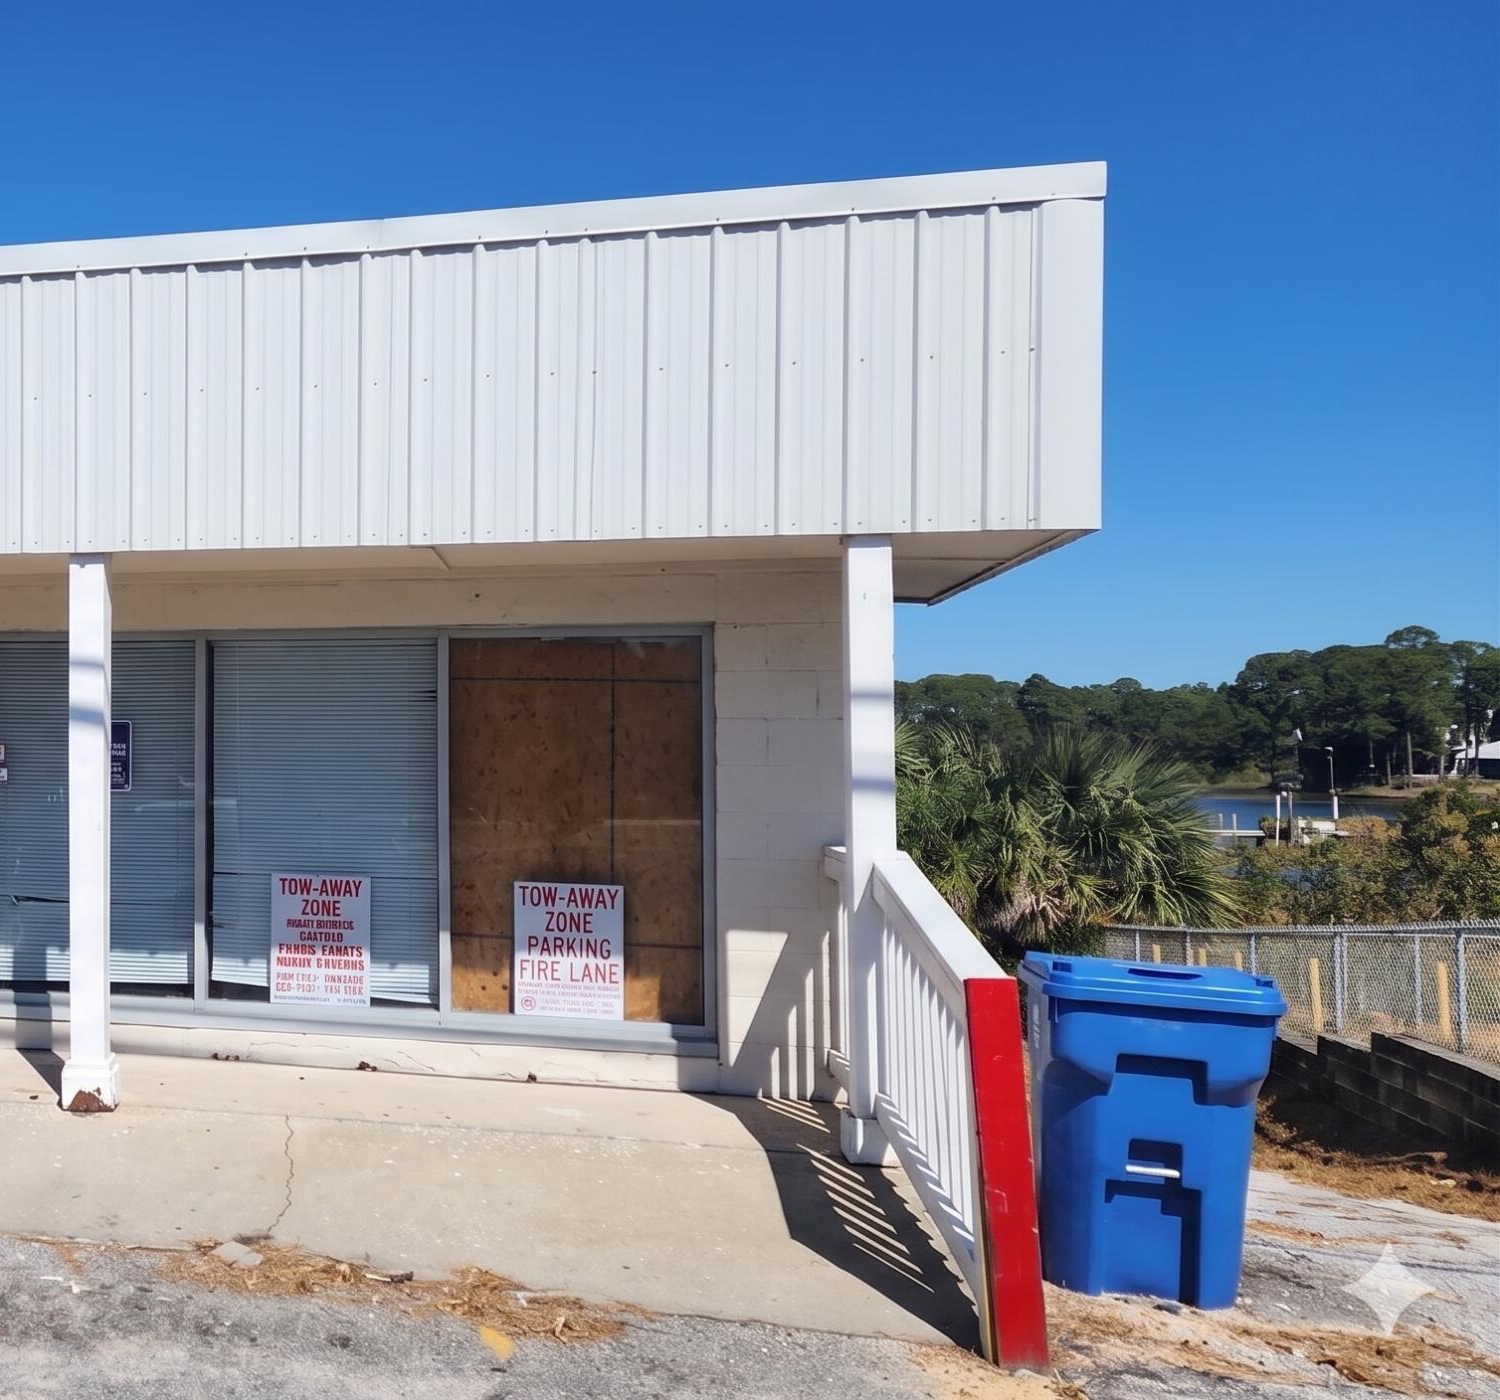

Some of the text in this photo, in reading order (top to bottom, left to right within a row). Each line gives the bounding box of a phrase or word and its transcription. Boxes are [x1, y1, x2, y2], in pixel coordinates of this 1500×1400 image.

[278, 877, 363, 898] TOW-AWAY
[518, 885, 620, 910] TOW-AWAY
[301, 899, 341, 917] ZONE
[545, 911, 594, 934] ZONE
[527, 935, 612, 960] PARKING
[520, 959, 620, 984] FIRE LANE
